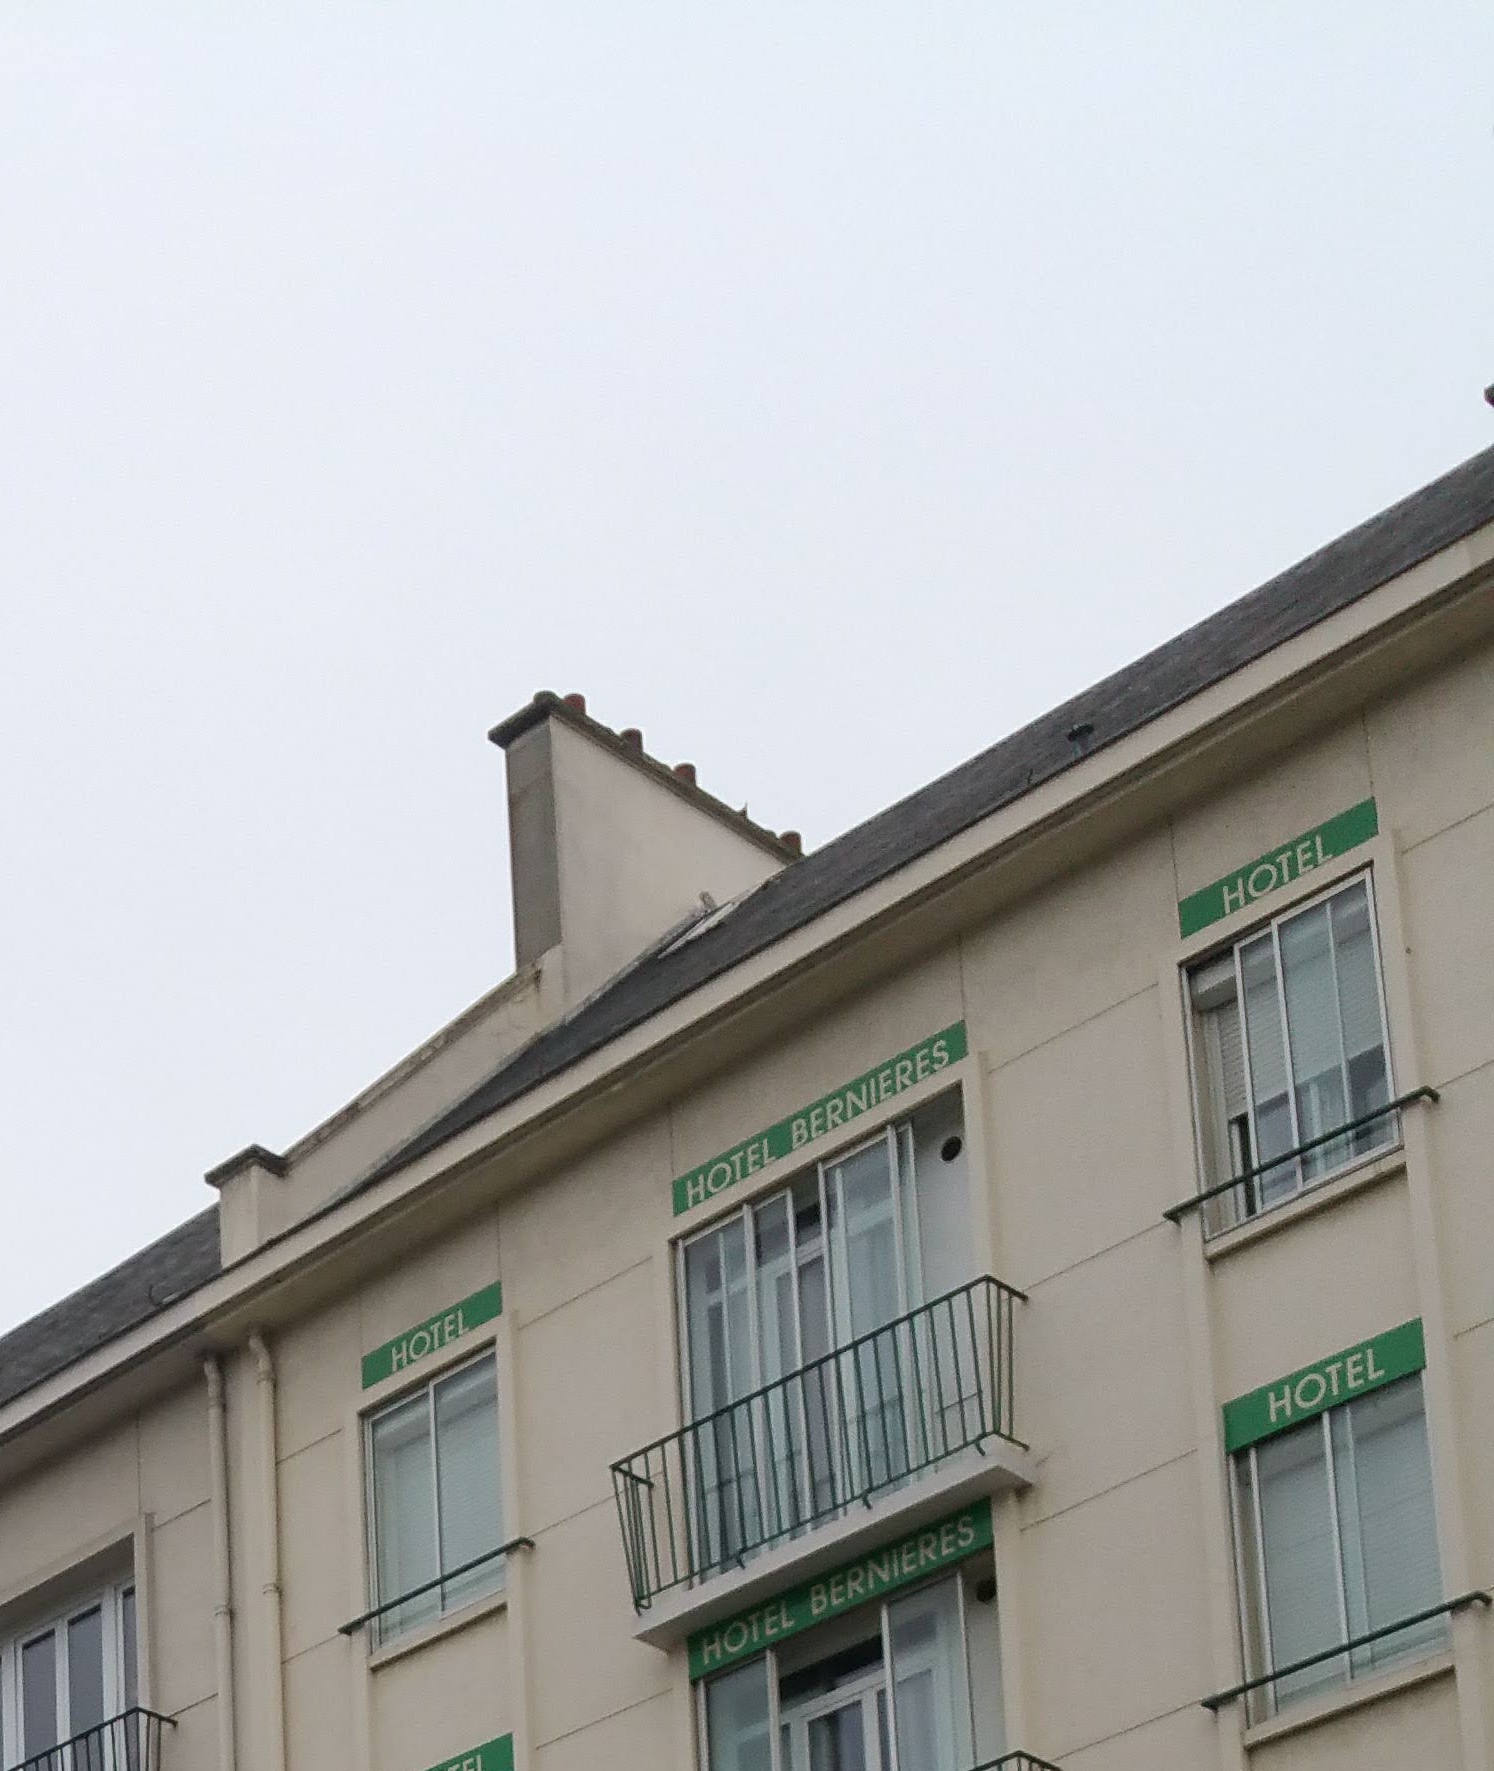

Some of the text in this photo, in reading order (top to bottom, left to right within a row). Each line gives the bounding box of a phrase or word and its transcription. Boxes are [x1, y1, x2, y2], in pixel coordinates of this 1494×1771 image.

[1222, 835, 1333, 914] HOTEL
[686, 1039, 950, 1208] HOTEL BERNIERES
[391, 1309, 470, 1372] HOTEL
[1267, 1348, 1386, 1423] HOTEL
[701, 1516, 975, 1666] HOTEL BERNIERES
